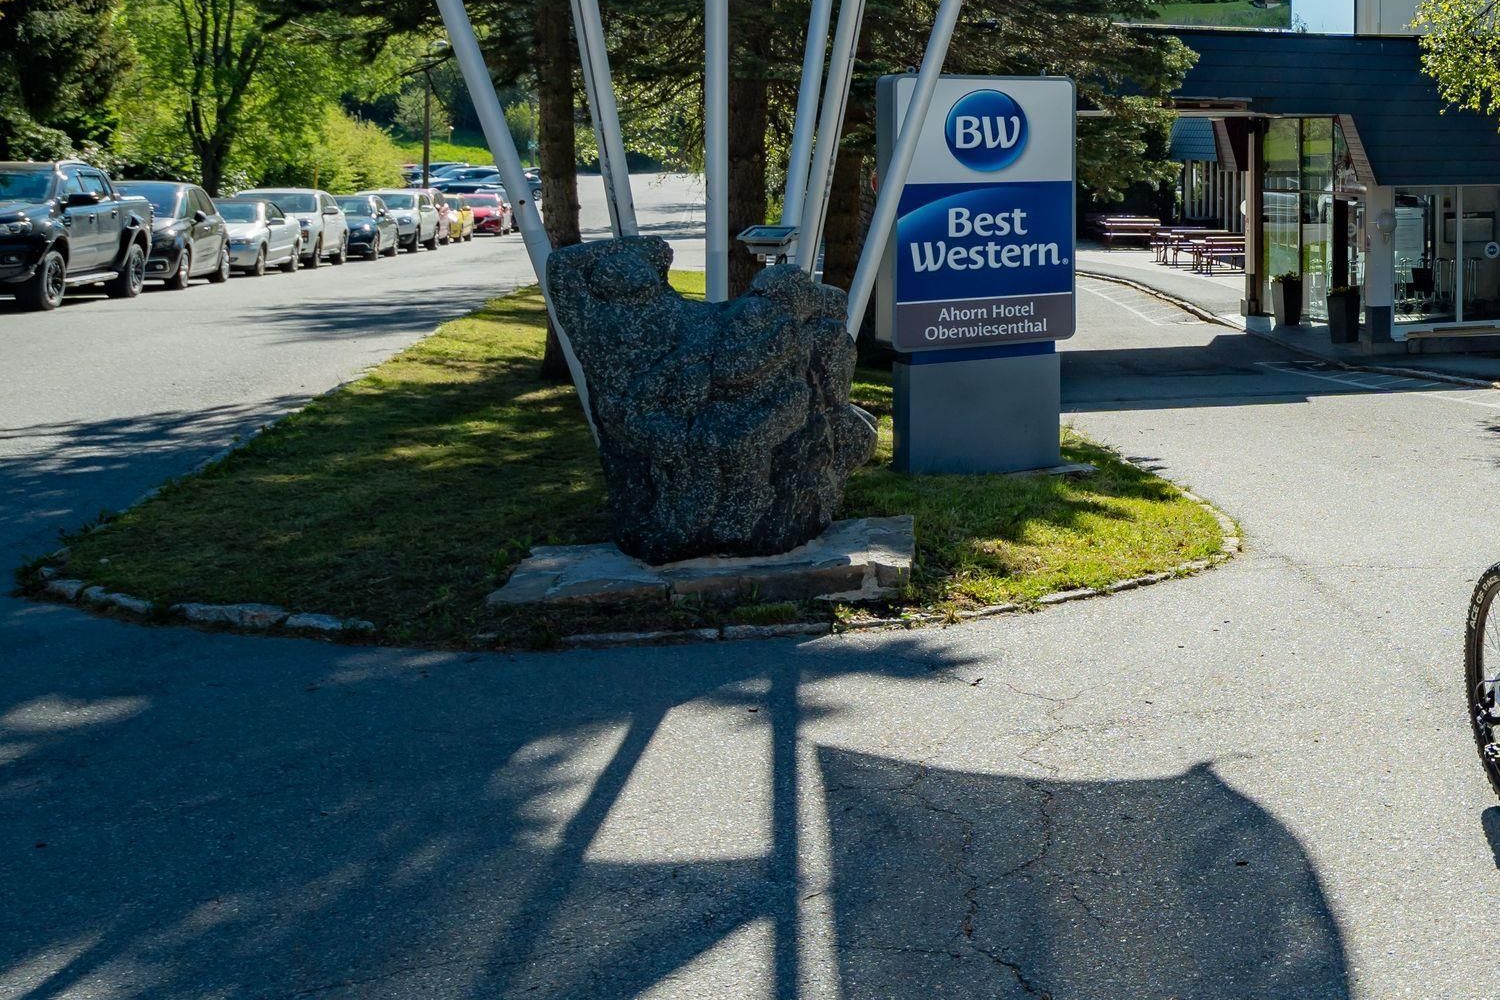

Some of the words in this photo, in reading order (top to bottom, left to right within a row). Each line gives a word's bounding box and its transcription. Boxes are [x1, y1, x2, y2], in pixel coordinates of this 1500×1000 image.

[955, 115, 1021, 149] BW
[948, 207, 1028, 238] Best
[938, 307, 987, 322] Ahorn
[993, 302, 1035, 317] Hotel
[925, 318, 1048, 340] Oberwiesenthal
[1469, 604, 1480, 629] ACE
[1482, 575, 1500, 592] PACE
